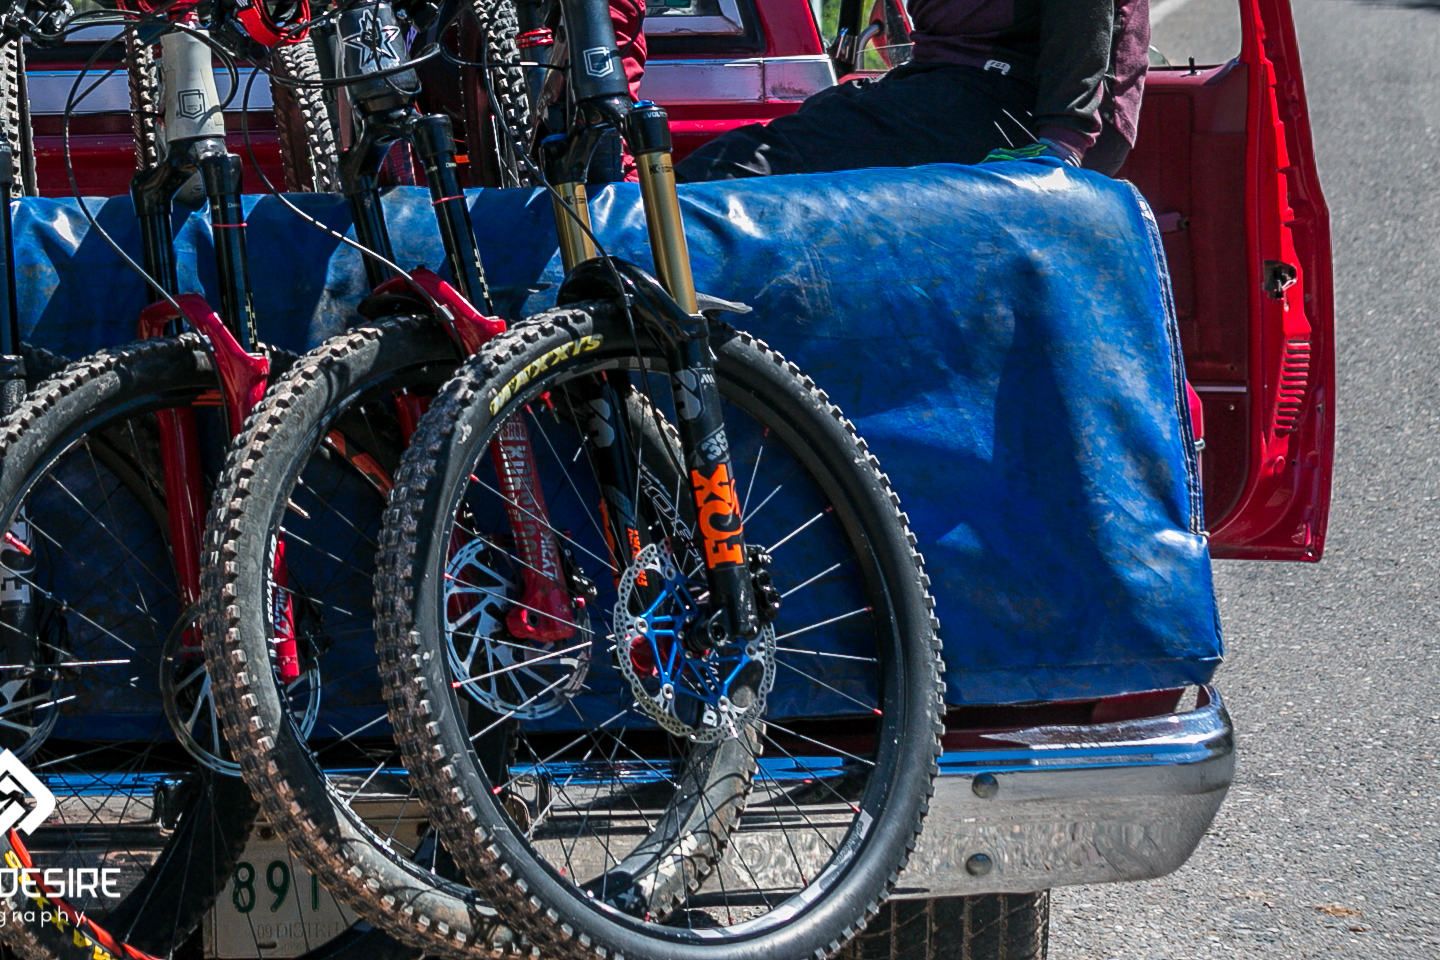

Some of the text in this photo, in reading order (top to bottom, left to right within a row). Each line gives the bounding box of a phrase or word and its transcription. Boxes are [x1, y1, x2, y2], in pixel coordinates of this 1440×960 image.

[489, 333, 604, 417] MAXXIS
[540, 530, 560, 581] LYRIK
[691, 463, 744, 570] FOX
